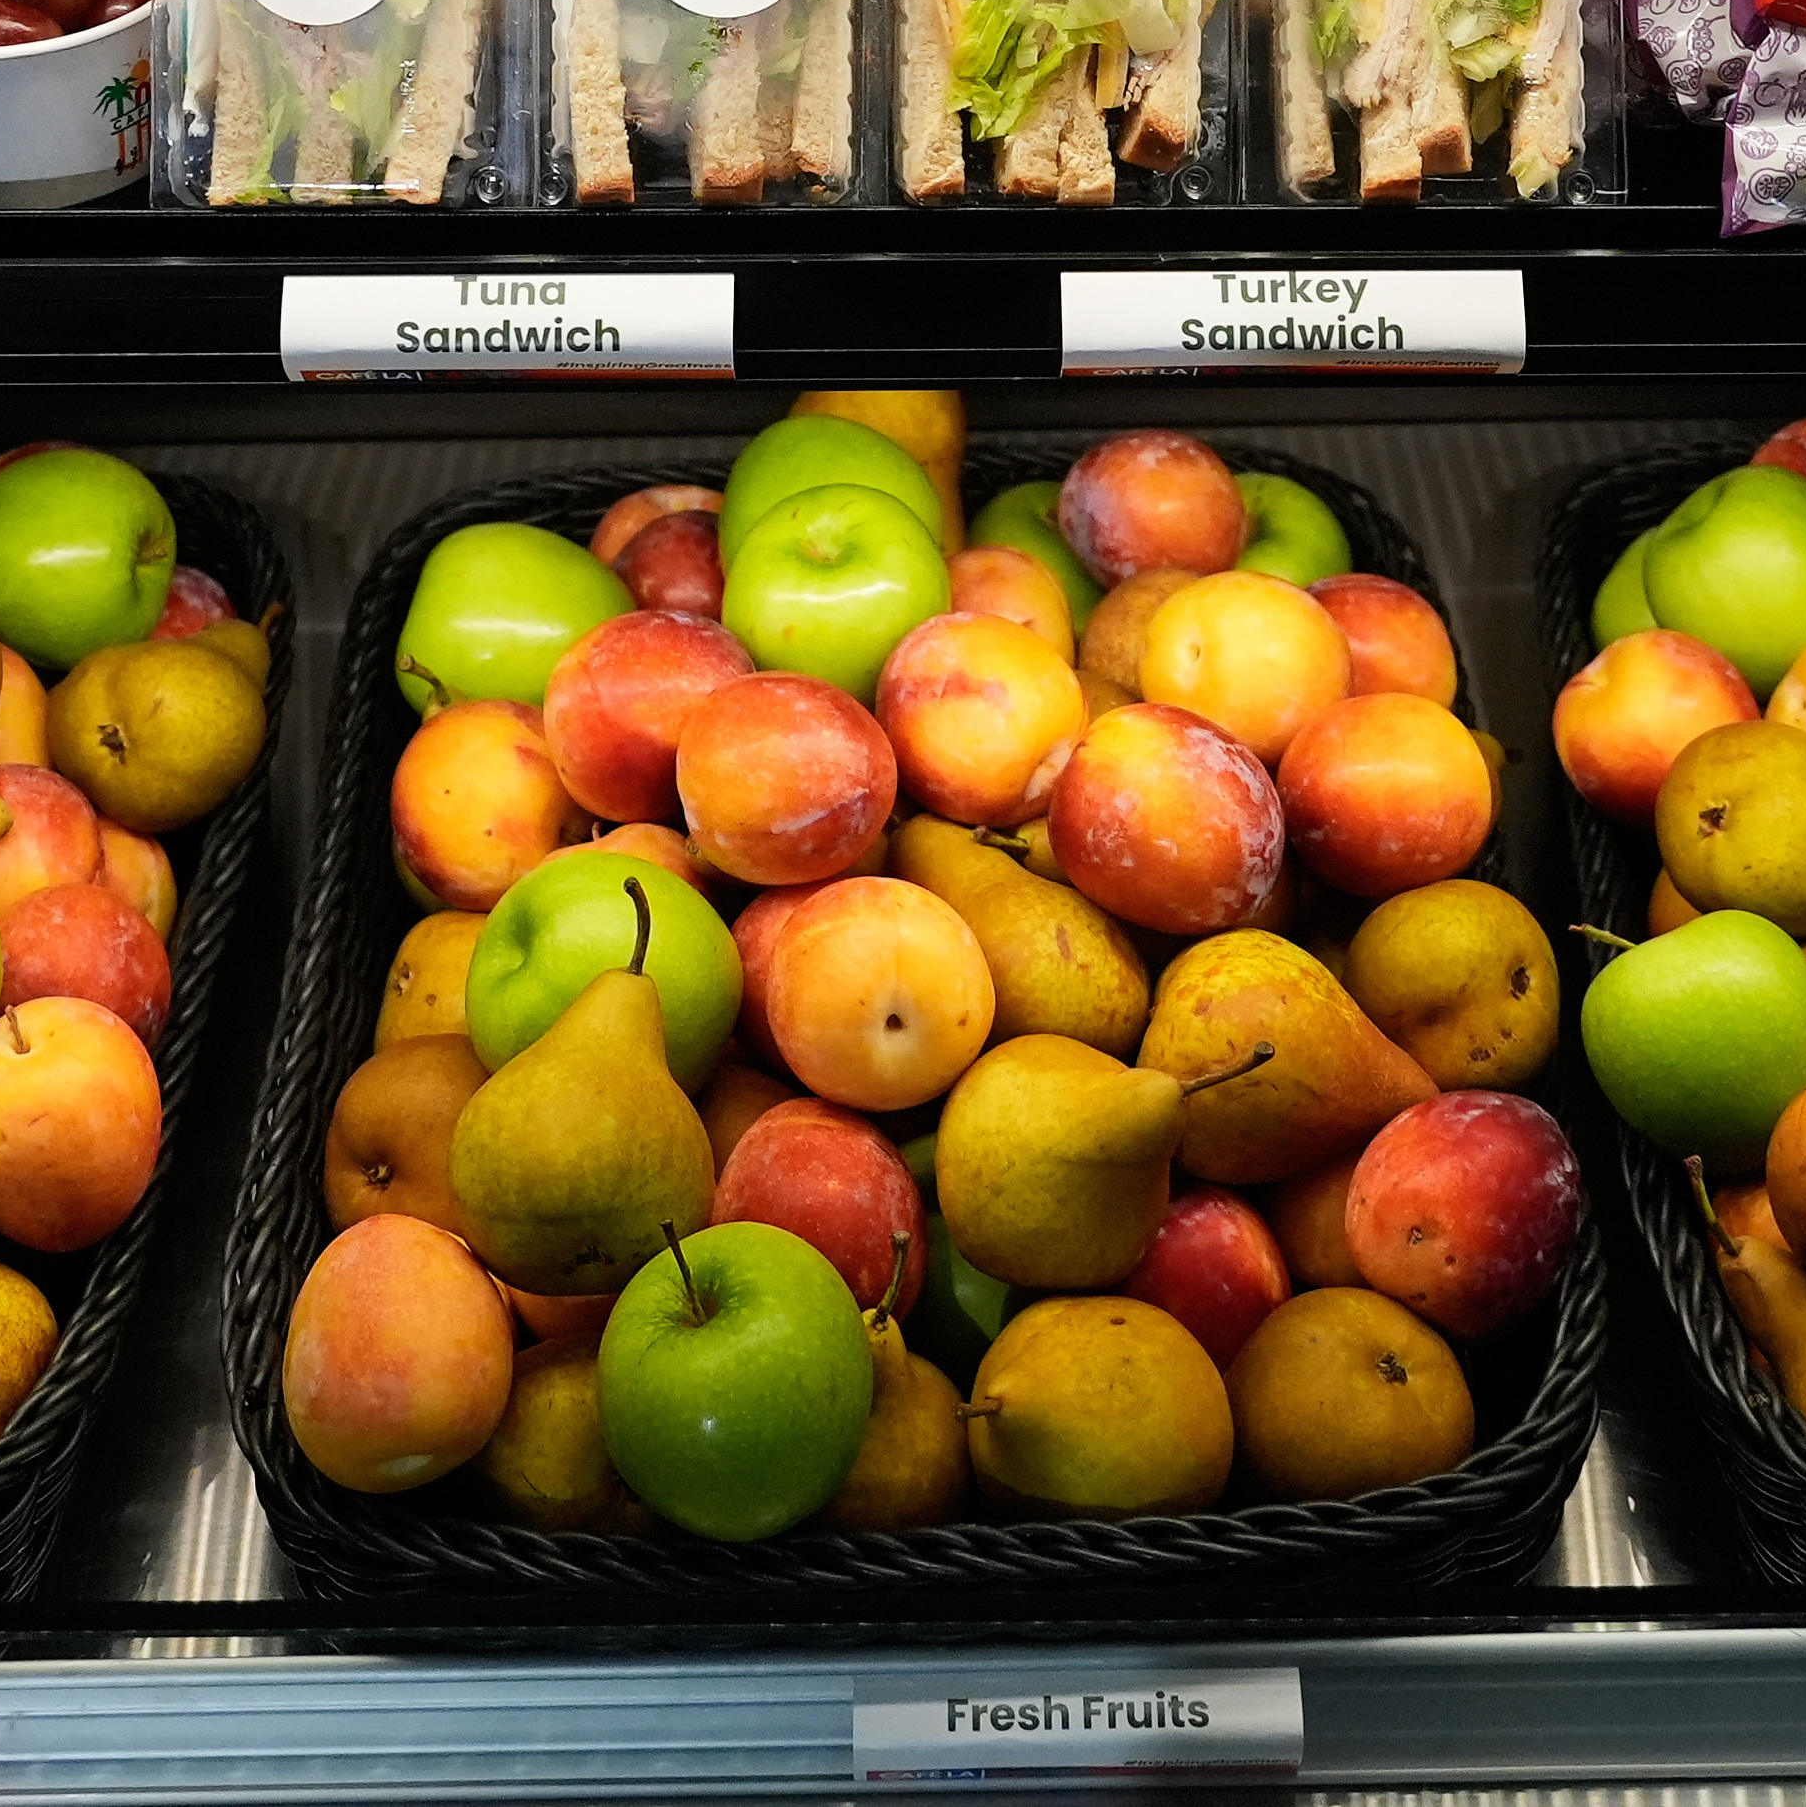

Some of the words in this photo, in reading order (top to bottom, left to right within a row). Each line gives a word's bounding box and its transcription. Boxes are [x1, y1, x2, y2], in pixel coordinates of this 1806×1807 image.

[112, 106, 152, 130] CAF
[453, 274, 566, 307] Tuna
[1212, 271, 1368, 314] Turkey
[396, 316, 621, 354] Sandwich
[1181, 314, 1404, 351] Sandwich
[382, 371, 413, 381] LA
[946, 1695, 1070, 1732] Fresh
[1082, 1690, 1210, 1729] Fruits
